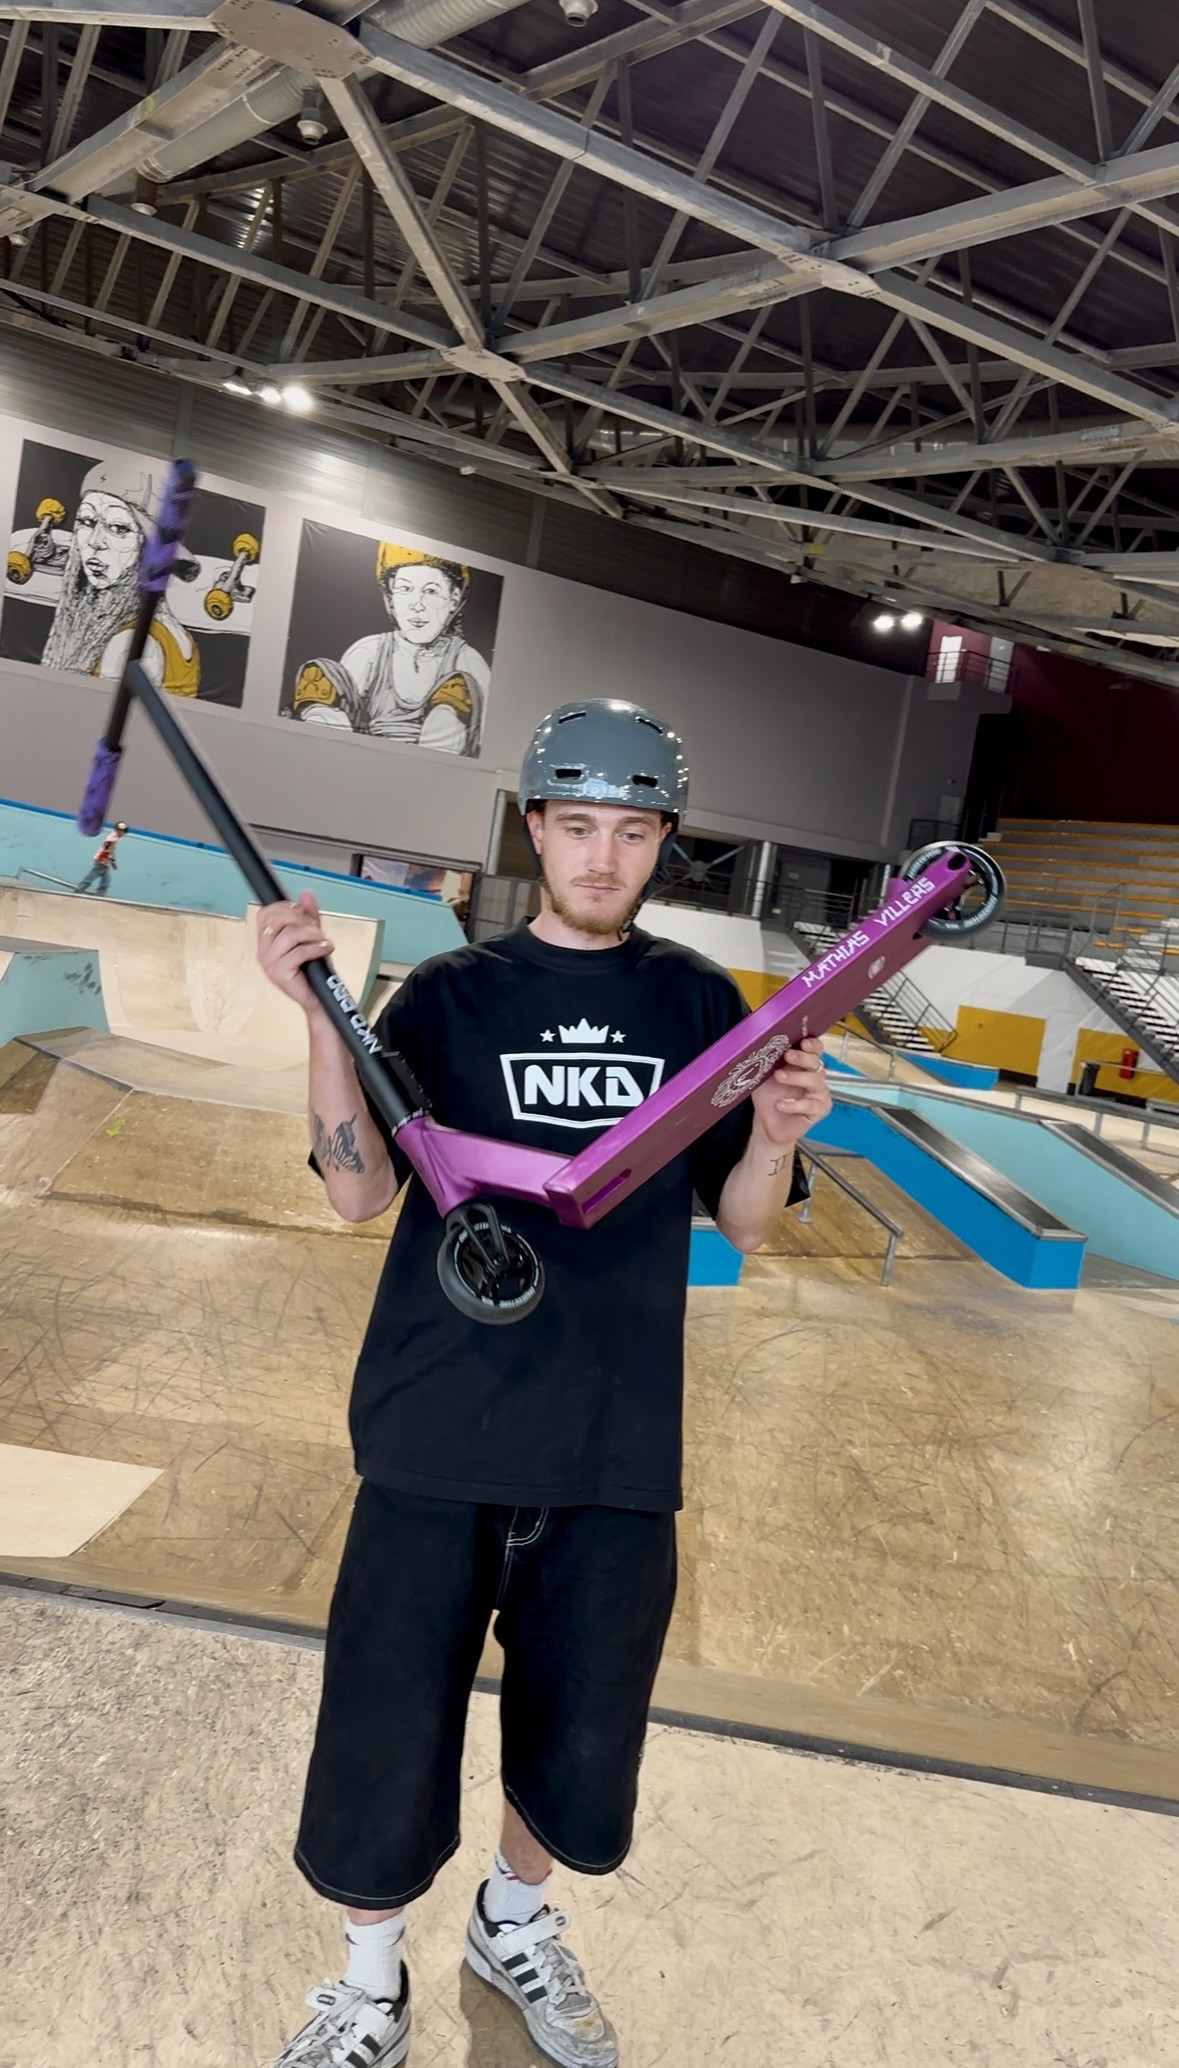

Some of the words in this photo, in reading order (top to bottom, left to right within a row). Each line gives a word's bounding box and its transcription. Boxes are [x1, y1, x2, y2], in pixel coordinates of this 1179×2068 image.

[802, 930, 870, 988] MATHIAS
[873, 877, 936, 927] VILLERS
[350, 1013, 383, 1055] NKD
[524, 1064, 645, 1107] NKD
